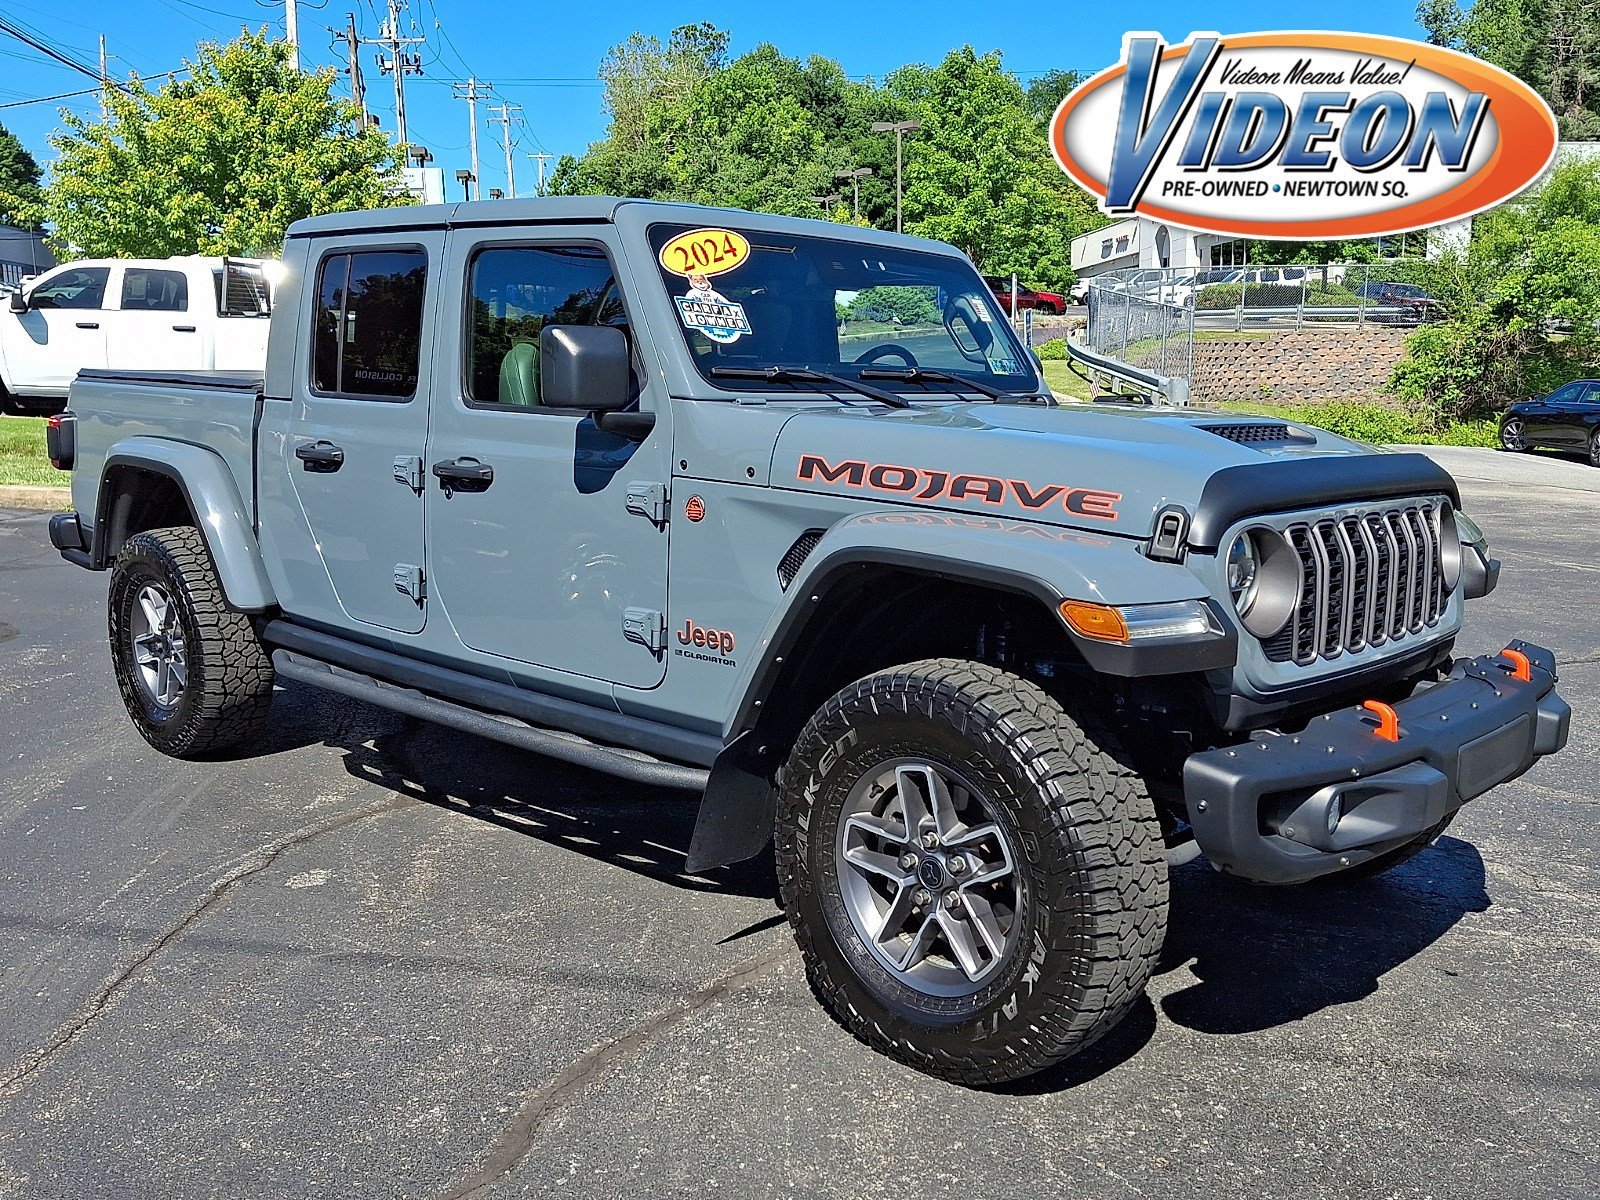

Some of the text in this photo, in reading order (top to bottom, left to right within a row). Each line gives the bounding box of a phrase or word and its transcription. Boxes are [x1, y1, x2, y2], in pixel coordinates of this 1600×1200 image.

[673, 233, 738, 272] 2024
[681, 301, 741, 318] CARFAX
[695, 313, 748, 330] OWNER
[797, 454, 1123, 521] MOJAVE
[676, 618, 736, 657] Jeep
[683, 650, 737, 668] GLADIATOR
